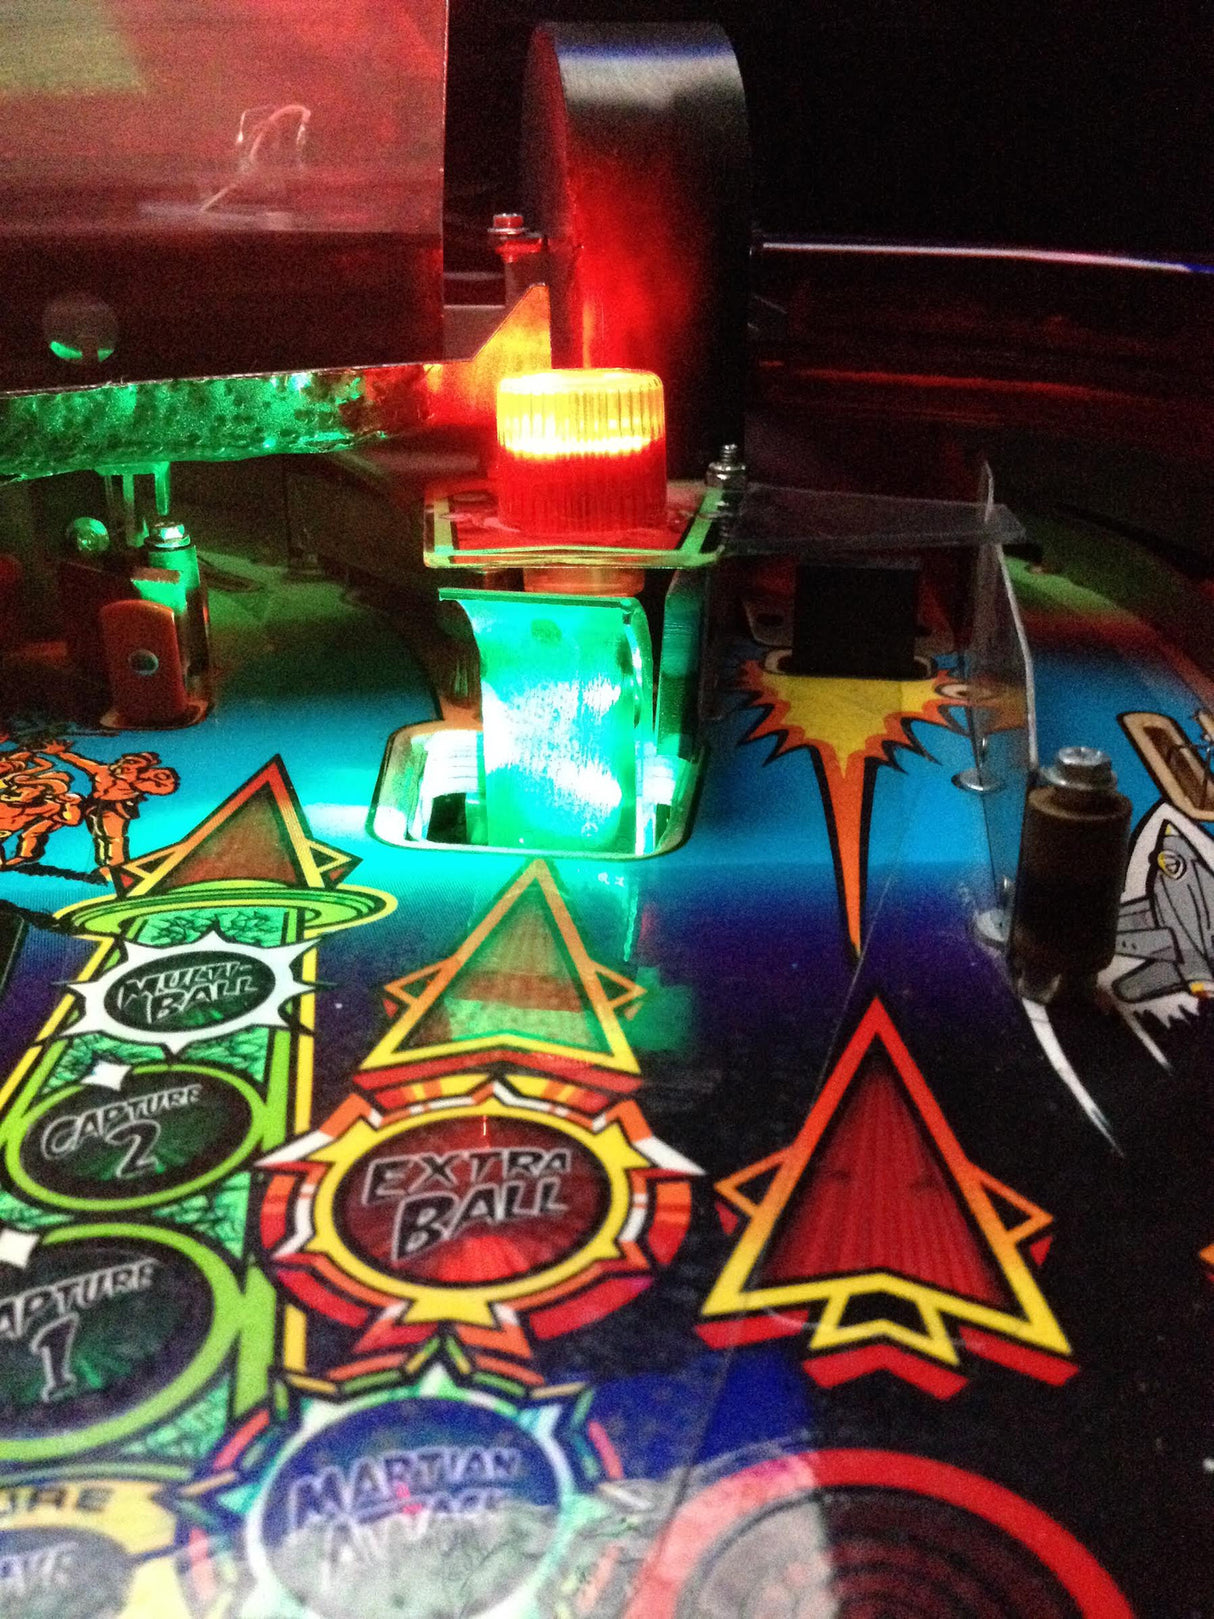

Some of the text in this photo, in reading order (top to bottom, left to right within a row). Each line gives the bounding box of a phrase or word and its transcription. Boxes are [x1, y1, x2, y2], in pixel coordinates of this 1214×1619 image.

[146, 975, 258, 1024] BALL
[40, 1083, 203, 1161] CAPTURE
[104, 1118, 161, 1179] 2
[360, 1146, 572, 1206] EXTRA
[390, 1176, 570, 1263] BALL
[29, 1310, 80, 1402] 1
[286, 1446, 523, 1532] MARTIAN
